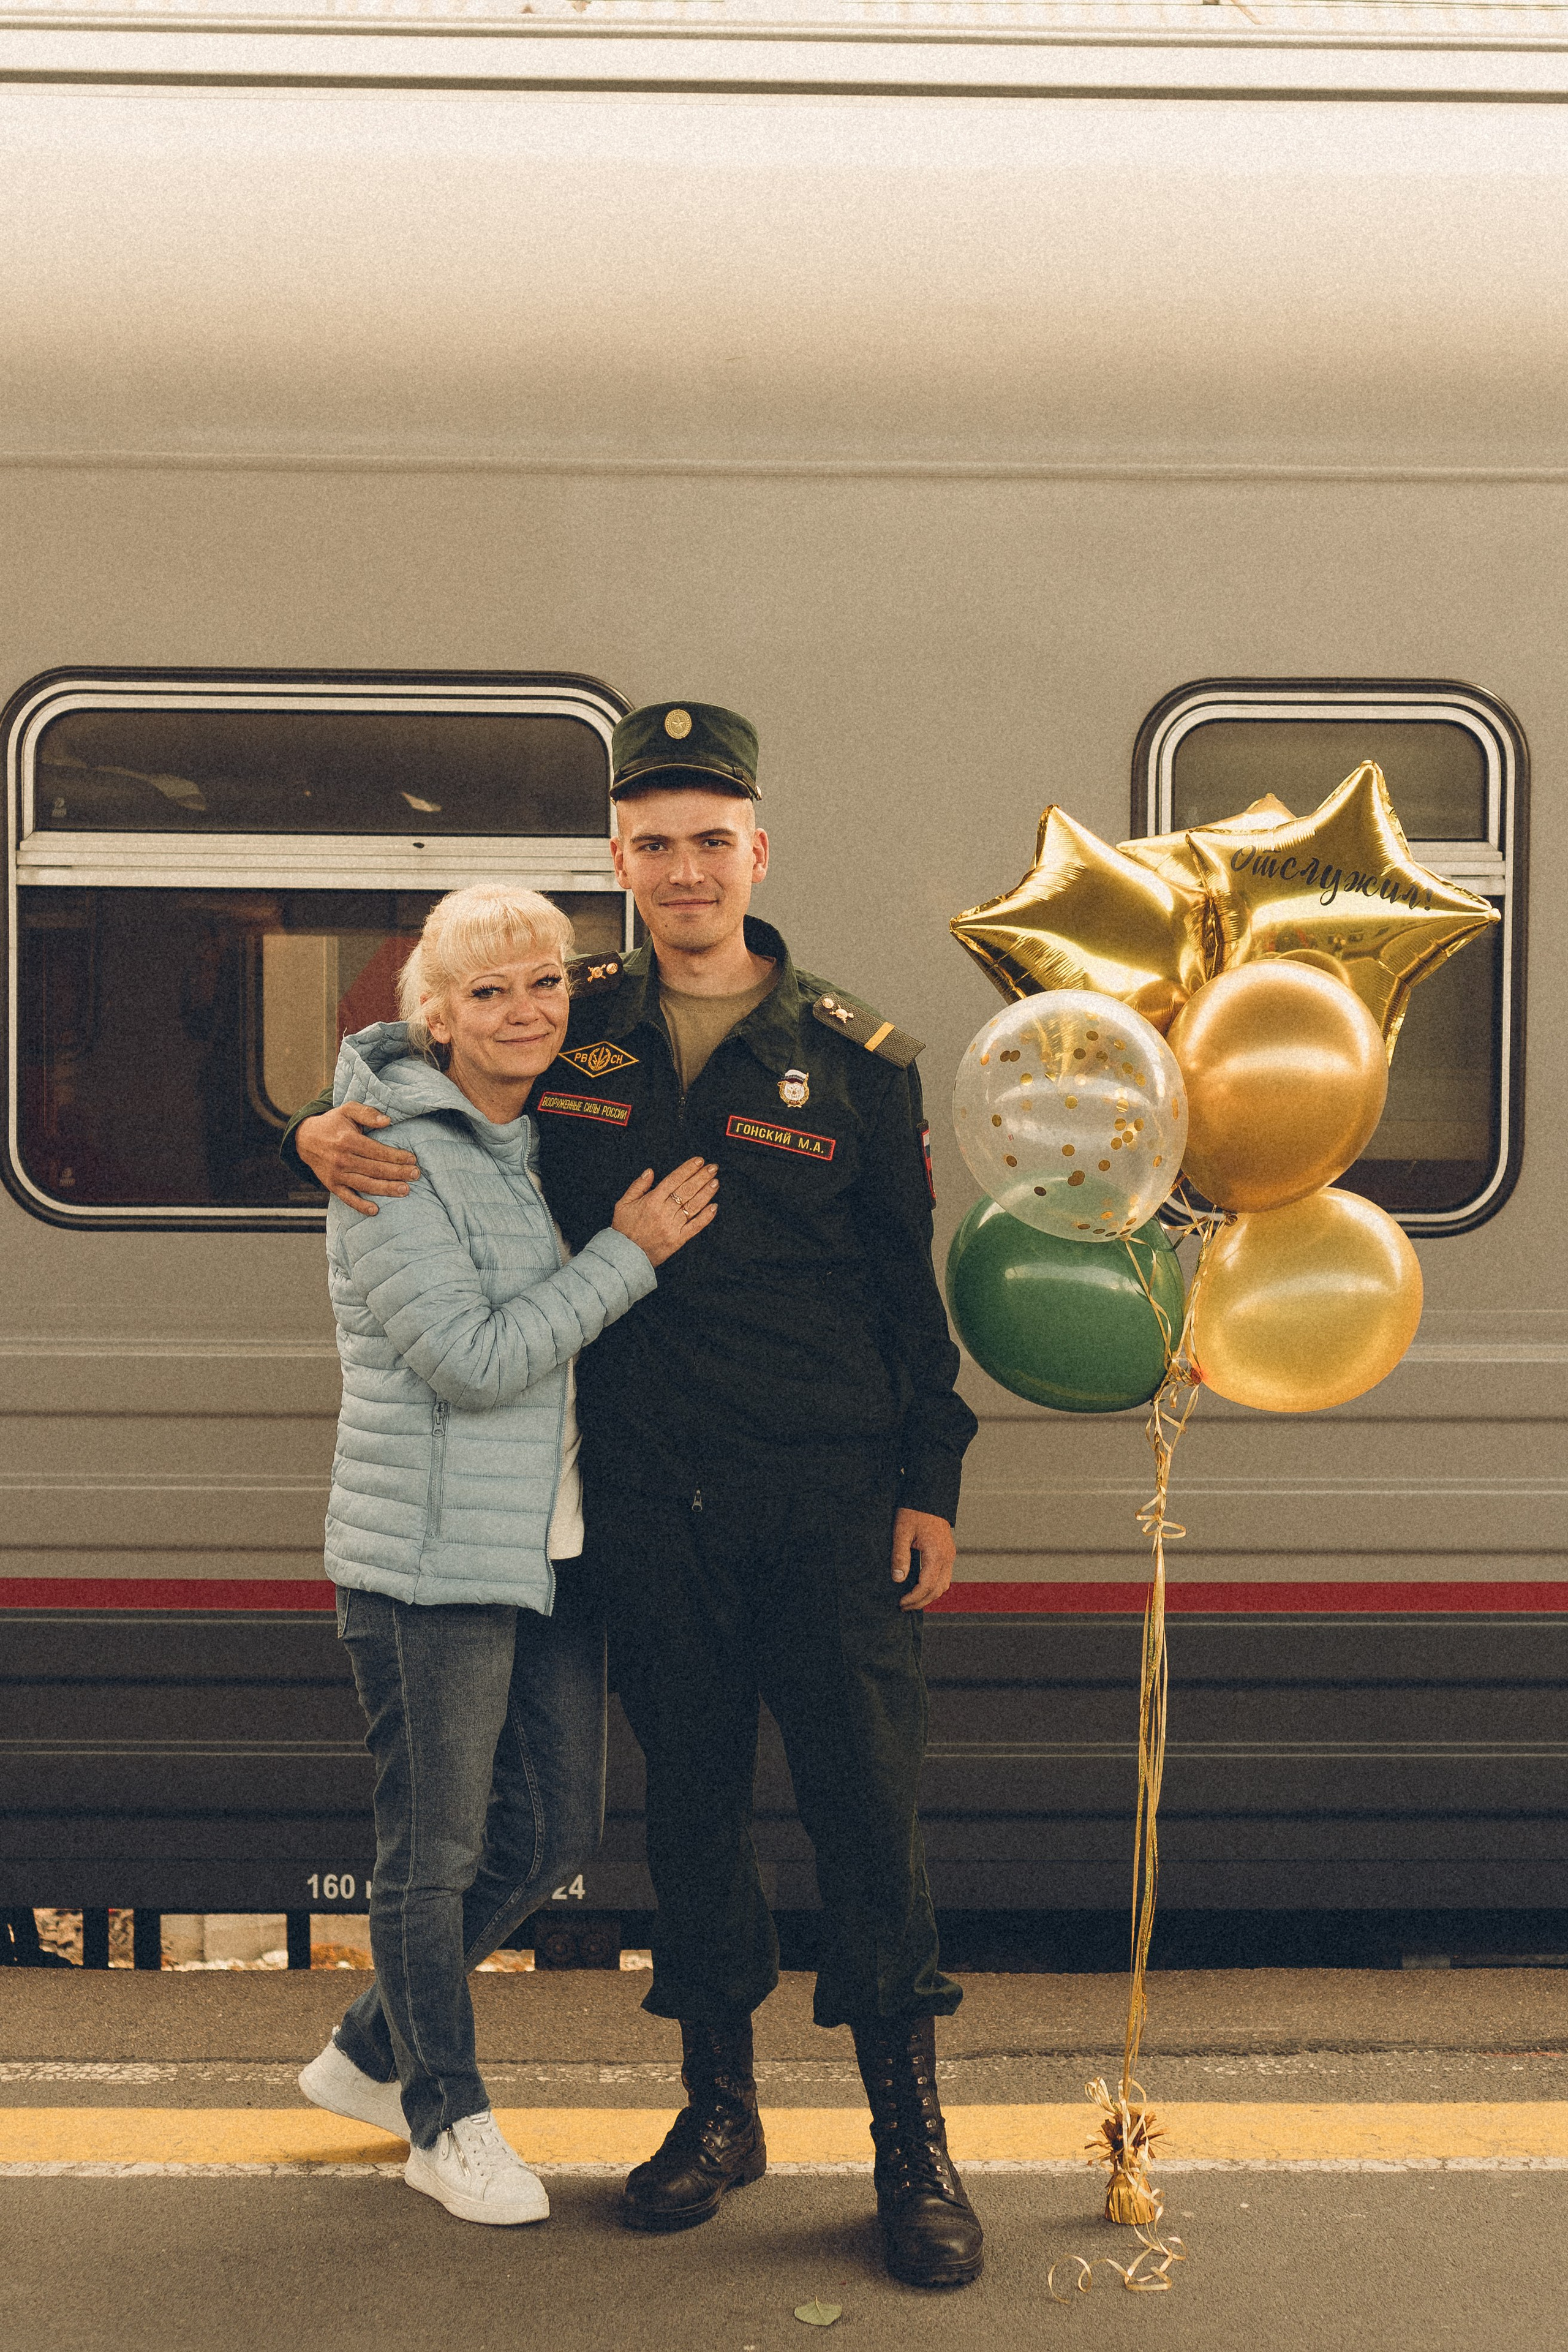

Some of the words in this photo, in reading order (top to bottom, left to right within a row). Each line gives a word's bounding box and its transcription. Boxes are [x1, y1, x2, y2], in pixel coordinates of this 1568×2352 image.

[1231, 845, 1433, 911] Отслужил!
[542, 1096, 583, 1111] ВООРУЖЕННЫЕ
[583, 1102, 601, 1114] СИЛЫ
[601, 1105, 628, 1120] РОССИИ
[736, 1123, 791, 1145] ГОНСКИЙ
[797, 1137, 824, 1154] М.А.
[307, 1874, 355, 1899] 160
